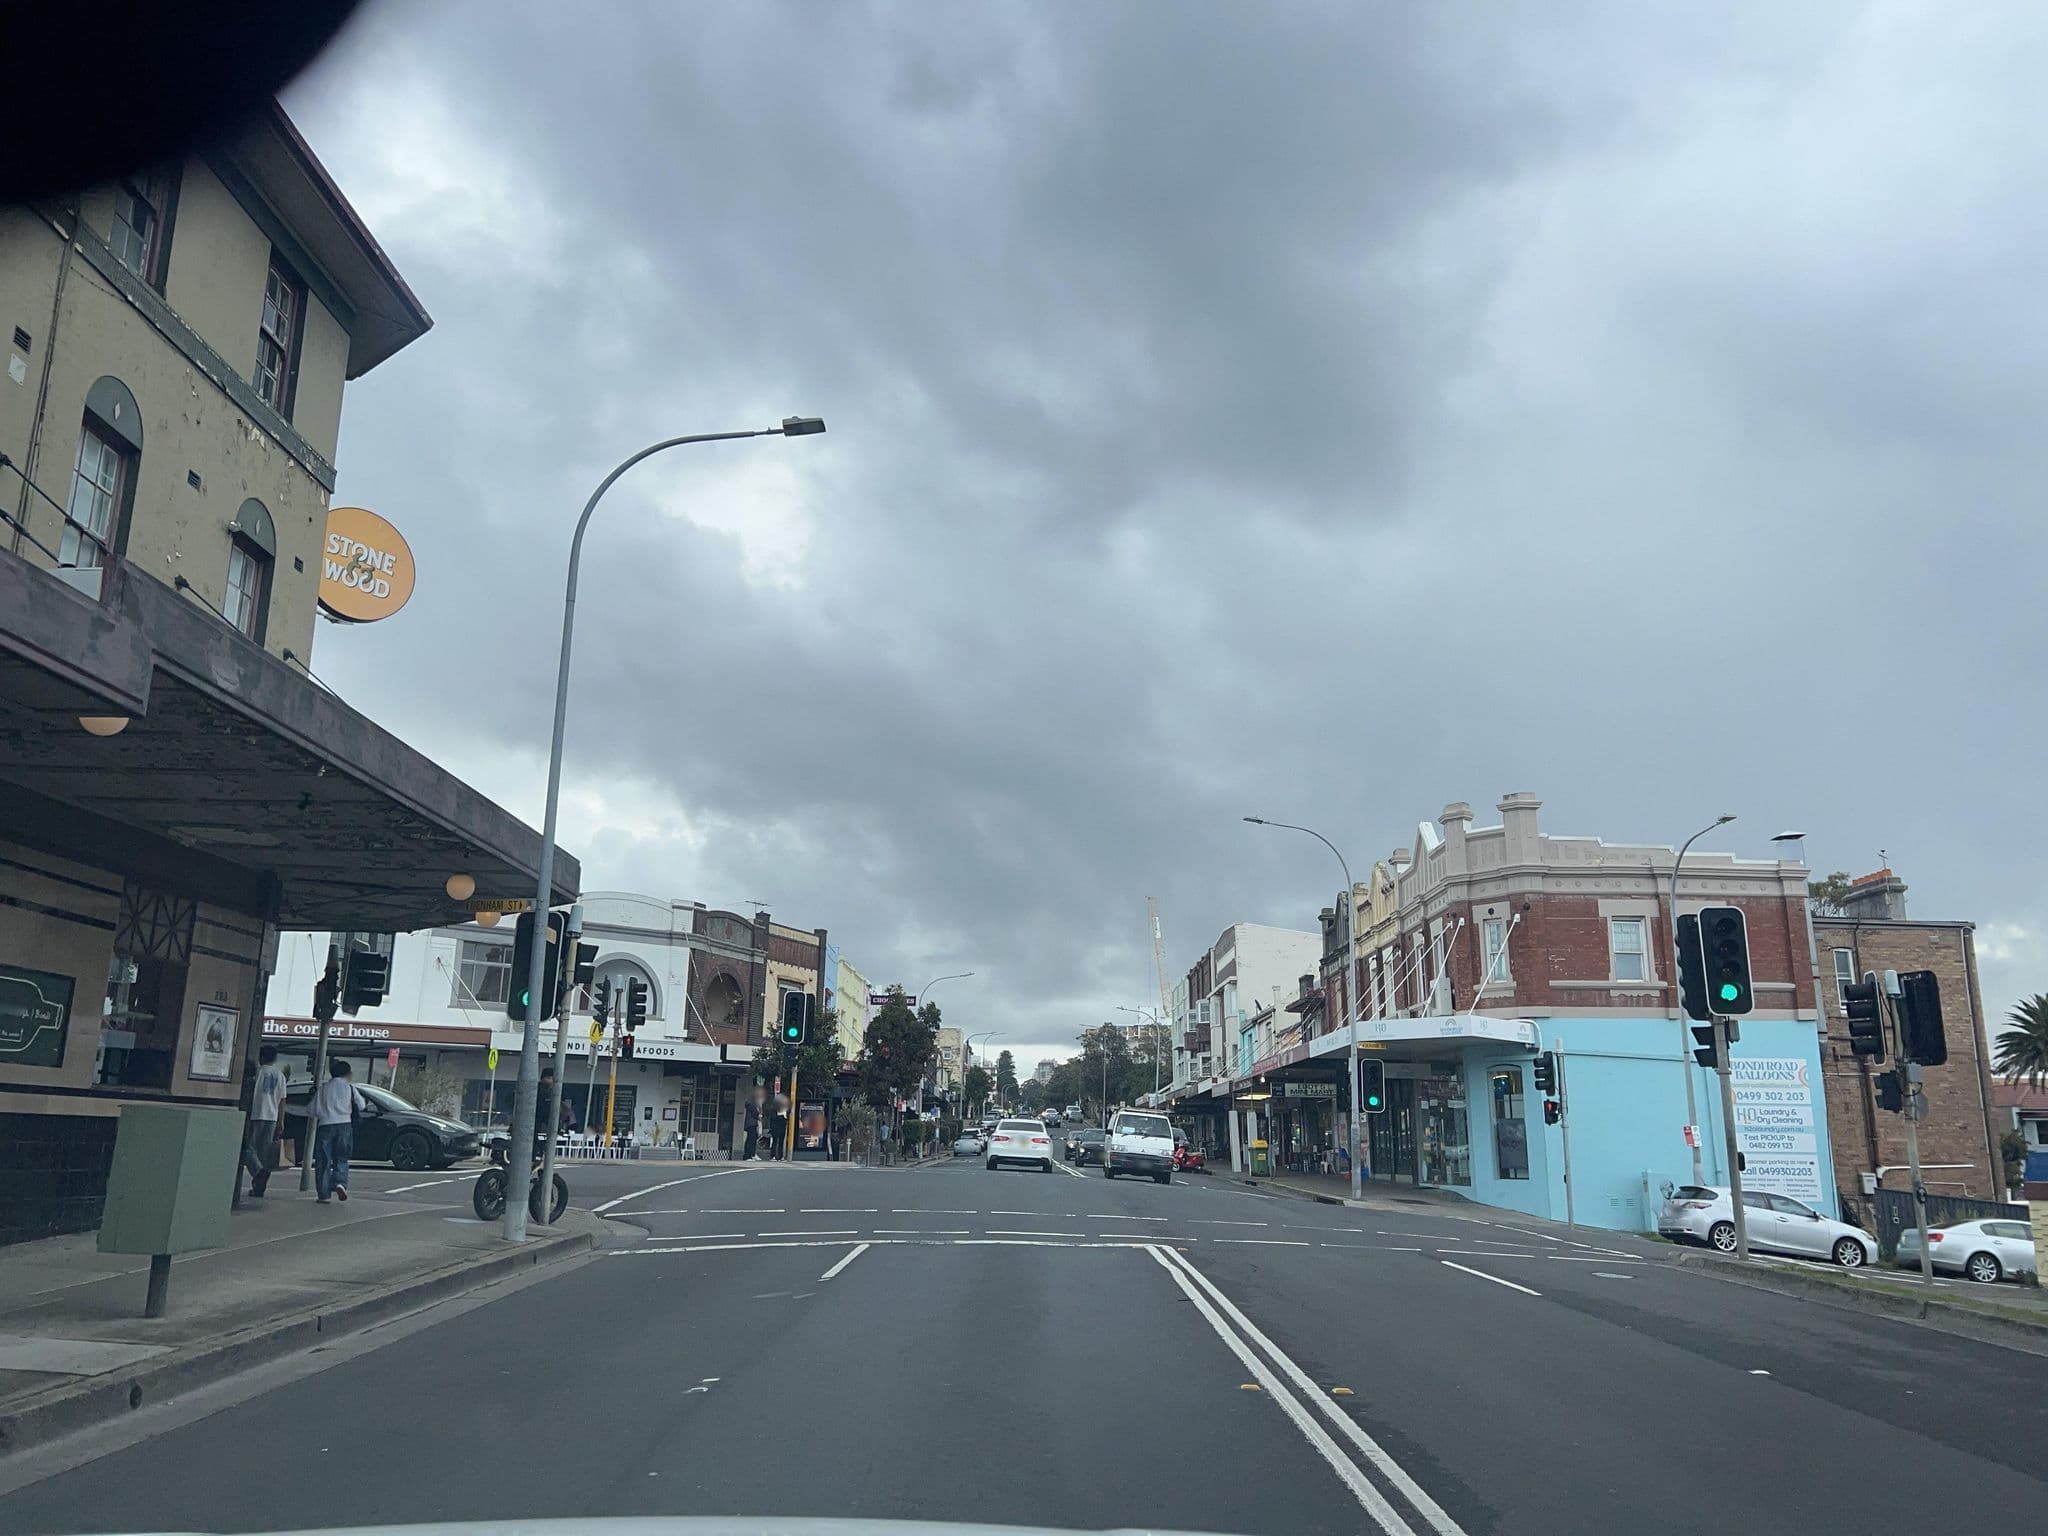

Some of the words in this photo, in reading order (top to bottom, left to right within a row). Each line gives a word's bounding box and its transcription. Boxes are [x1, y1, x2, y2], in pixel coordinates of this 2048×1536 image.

[326, 533, 396, 577] STONE
[323, 557, 391, 599] WOOD
[507, 901, 518, 911] ST
[263, 1019, 289, 1034] the
[293, 1023, 344, 1036] corer
[347, 1024, 390, 1039] house
[552, 1041, 586, 1051] BNDI
[633, 1048, 676, 1057] AFOODS
[1730, 1061, 1764, 1071] BONDI
[1765, 1061, 1798, 1071] ROAD
[1735, 1070, 1795, 1080] BALLOONS
[1736, 1091, 1761, 1101] 0499
[1765, 1091, 1784, 1101] 302
[1786, 1091, 1805, 1101] 203
[1759, 1108, 1790, 1117] Laundry
[1790, 1108, 1798, 1116] &
[1757, 1116, 1771, 1125] Dry
[1771, 1116, 1804, 1125] Cleaning
[1781, 1142, 1794, 1150] 123
[1758, 1167, 1813, 1176] 0499302203
